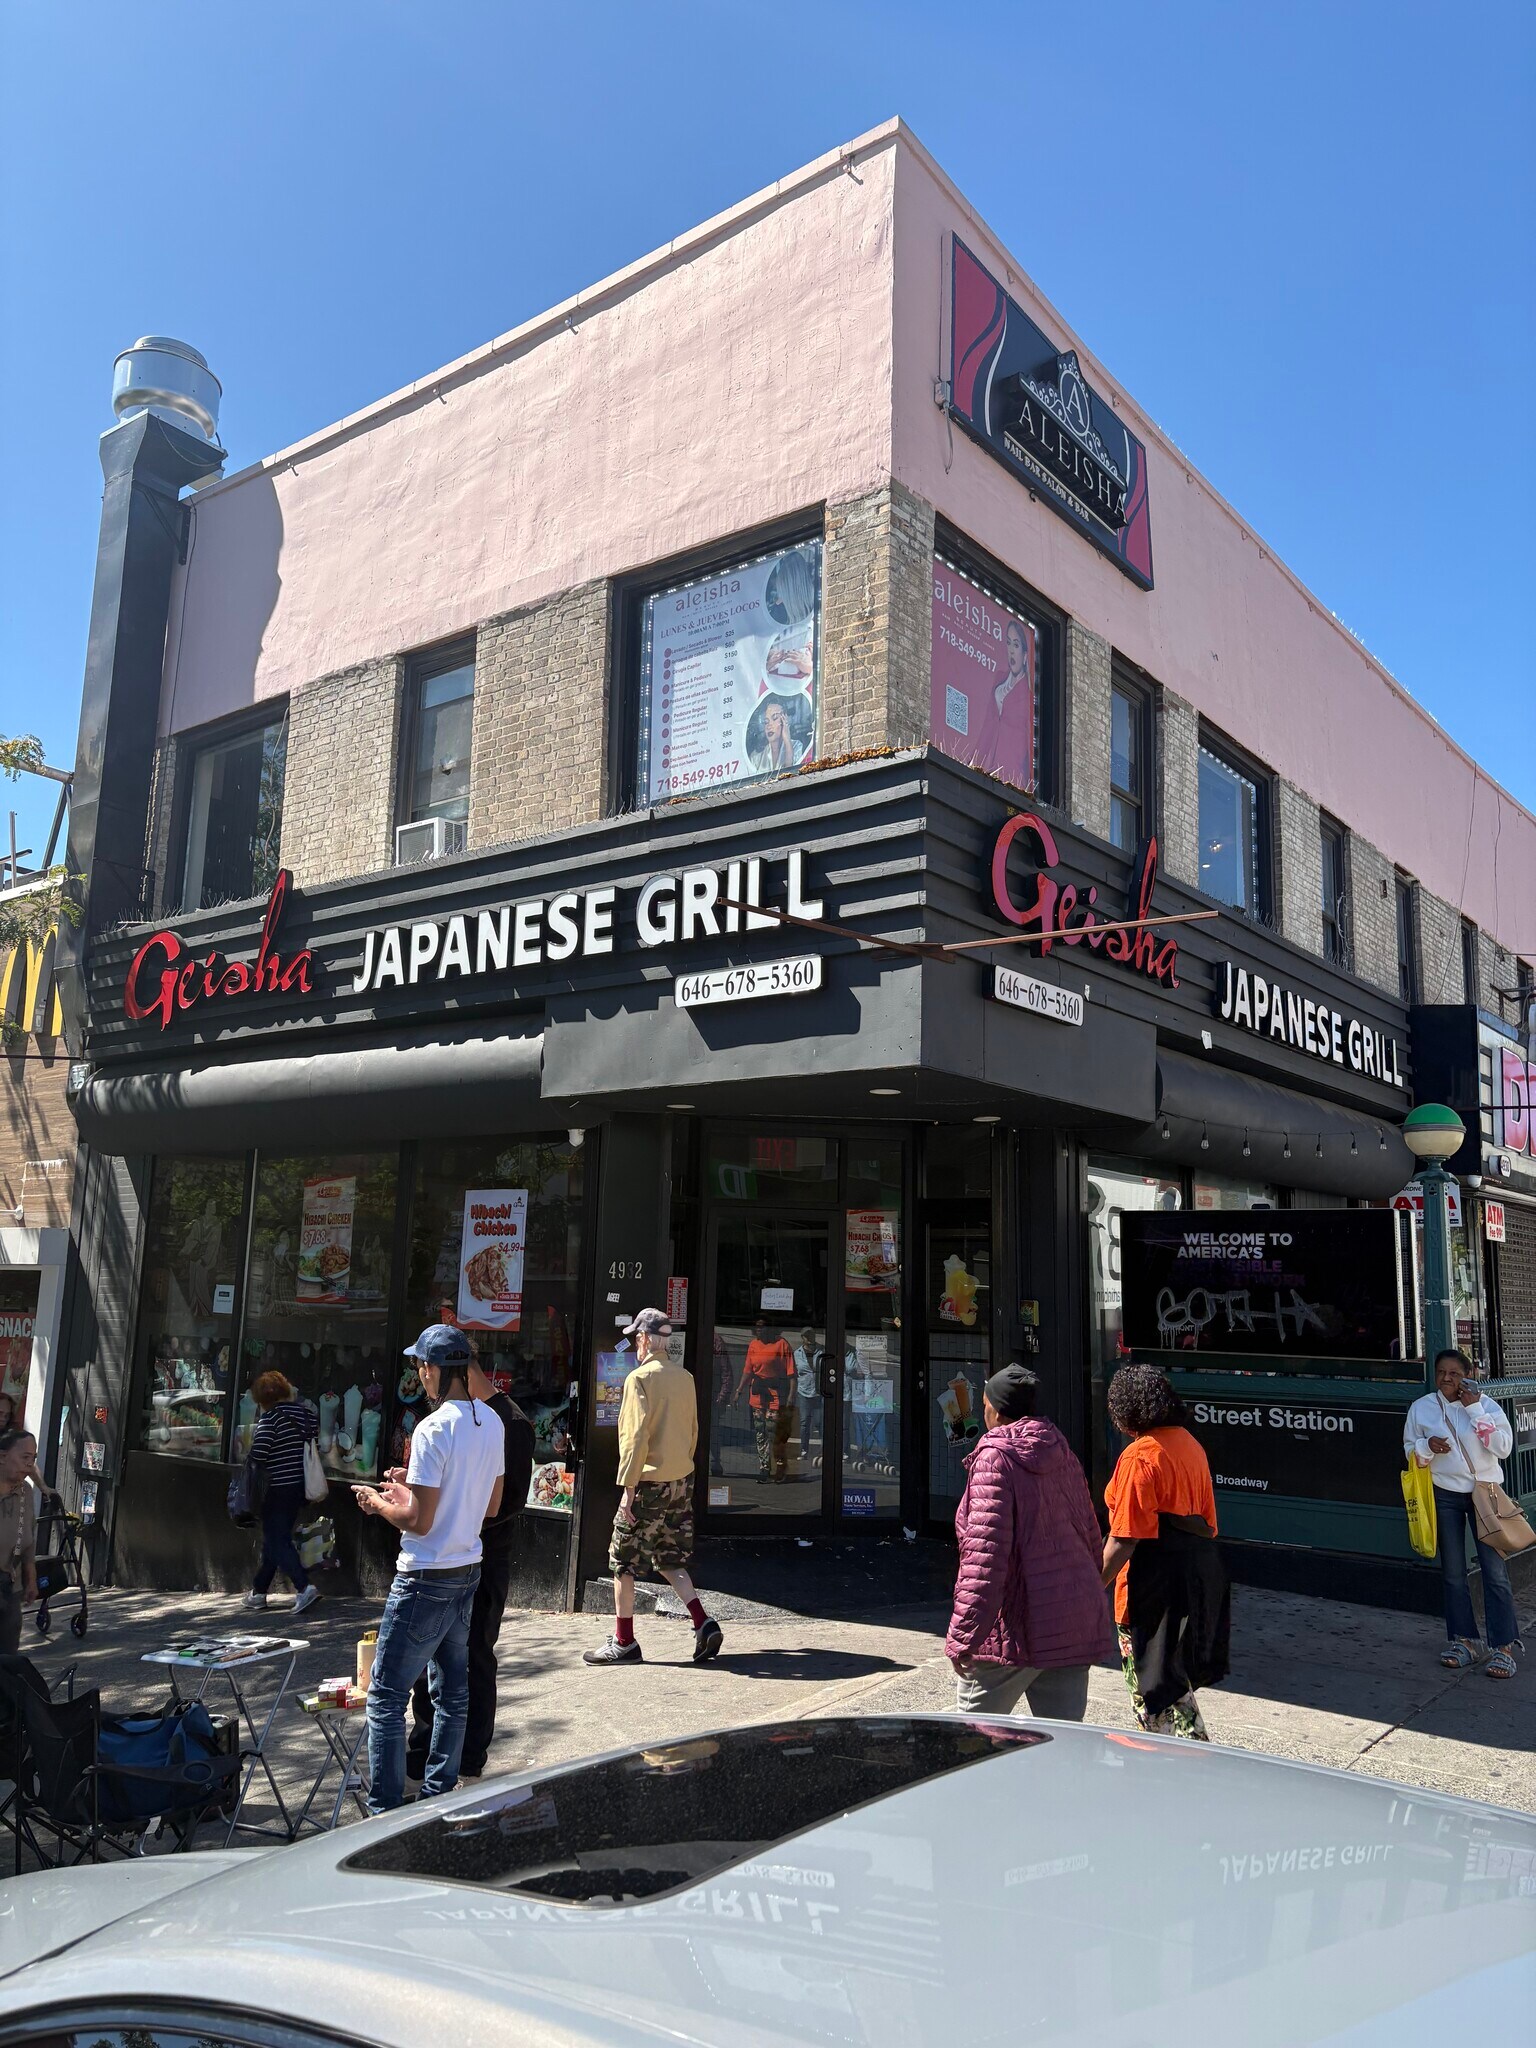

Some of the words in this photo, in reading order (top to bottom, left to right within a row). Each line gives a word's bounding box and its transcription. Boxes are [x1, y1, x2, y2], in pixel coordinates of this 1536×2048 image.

[1019, 399, 1127, 524] ALEISHA
[1004, 436, 1024, 462] NAIL
[1024, 456, 1041, 478] BAR
[1042, 472, 1067, 501] SALON
[1067, 496, 1074, 507] &
[1075, 499, 1090, 522] BAR
[675, 580, 741, 612] aleisha
[660, 625, 688, 640] LUNES
[688, 621, 696, 631] &
[696, 609, 729, 628] JUEVES
[730, 599, 761, 617] LOCOS
[934, 579, 1003, 642] aleisha
[725, 629, 735, 638] $25
[939, 625, 998, 673] 718-549-9817
[693, 672, 712, 682] Pedicure
[724, 664, 734, 673] $50
[723, 680, 734, 689] $50
[673, 708, 692, 719] Pedicure
[692, 704, 708, 714] Regular
[722, 695, 733, 705] $35
[692, 719, 708, 729] Regular
[722, 711, 733, 720] $25
[722, 741, 732, 750] $20
[657, 760, 739, 793] 718-549-9817
[991, 812, 1180, 989] Geisha
[352, 885, 617, 993] JAPANESE
[636, 848, 824, 948] GRILL
[124, 868, 314, 1032] Geisha
[681, 960, 814, 1002] 646-678-5360
[999, 972, 1080, 1021] 646-678-5360
[1221, 961, 1344, 1064] JAPANESE
[1348, 1019, 1403, 1088] GRILL
[304, 1212, 327, 1226] HIBACHI
[327, 1212, 352, 1226] CHICKEN
[470, 1203, 512, 1220] Hibachi
[1487, 1204, 1504, 1226] ATM
[303, 1229, 326, 1247] $7.68
[473, 1220, 518, 1237] Chicken
[848, 1231, 871, 1241] HIBACHI
[497, 1241, 520, 1255] $4.99
[1183, 1232, 1266, 1246] WELCOME
[1269, 1232, 1293, 1246] TO
[850, 1244, 870, 1255] $7.68
[1177, 1246, 1264, 1259] AMERICA'S
[1194, 1403, 1262, 1427] Street
[1268, 1407, 1354, 1433] Station
[1216, 1474, 1269, 1490] Broadway
[843, 1494, 873, 1504] ROYAL
